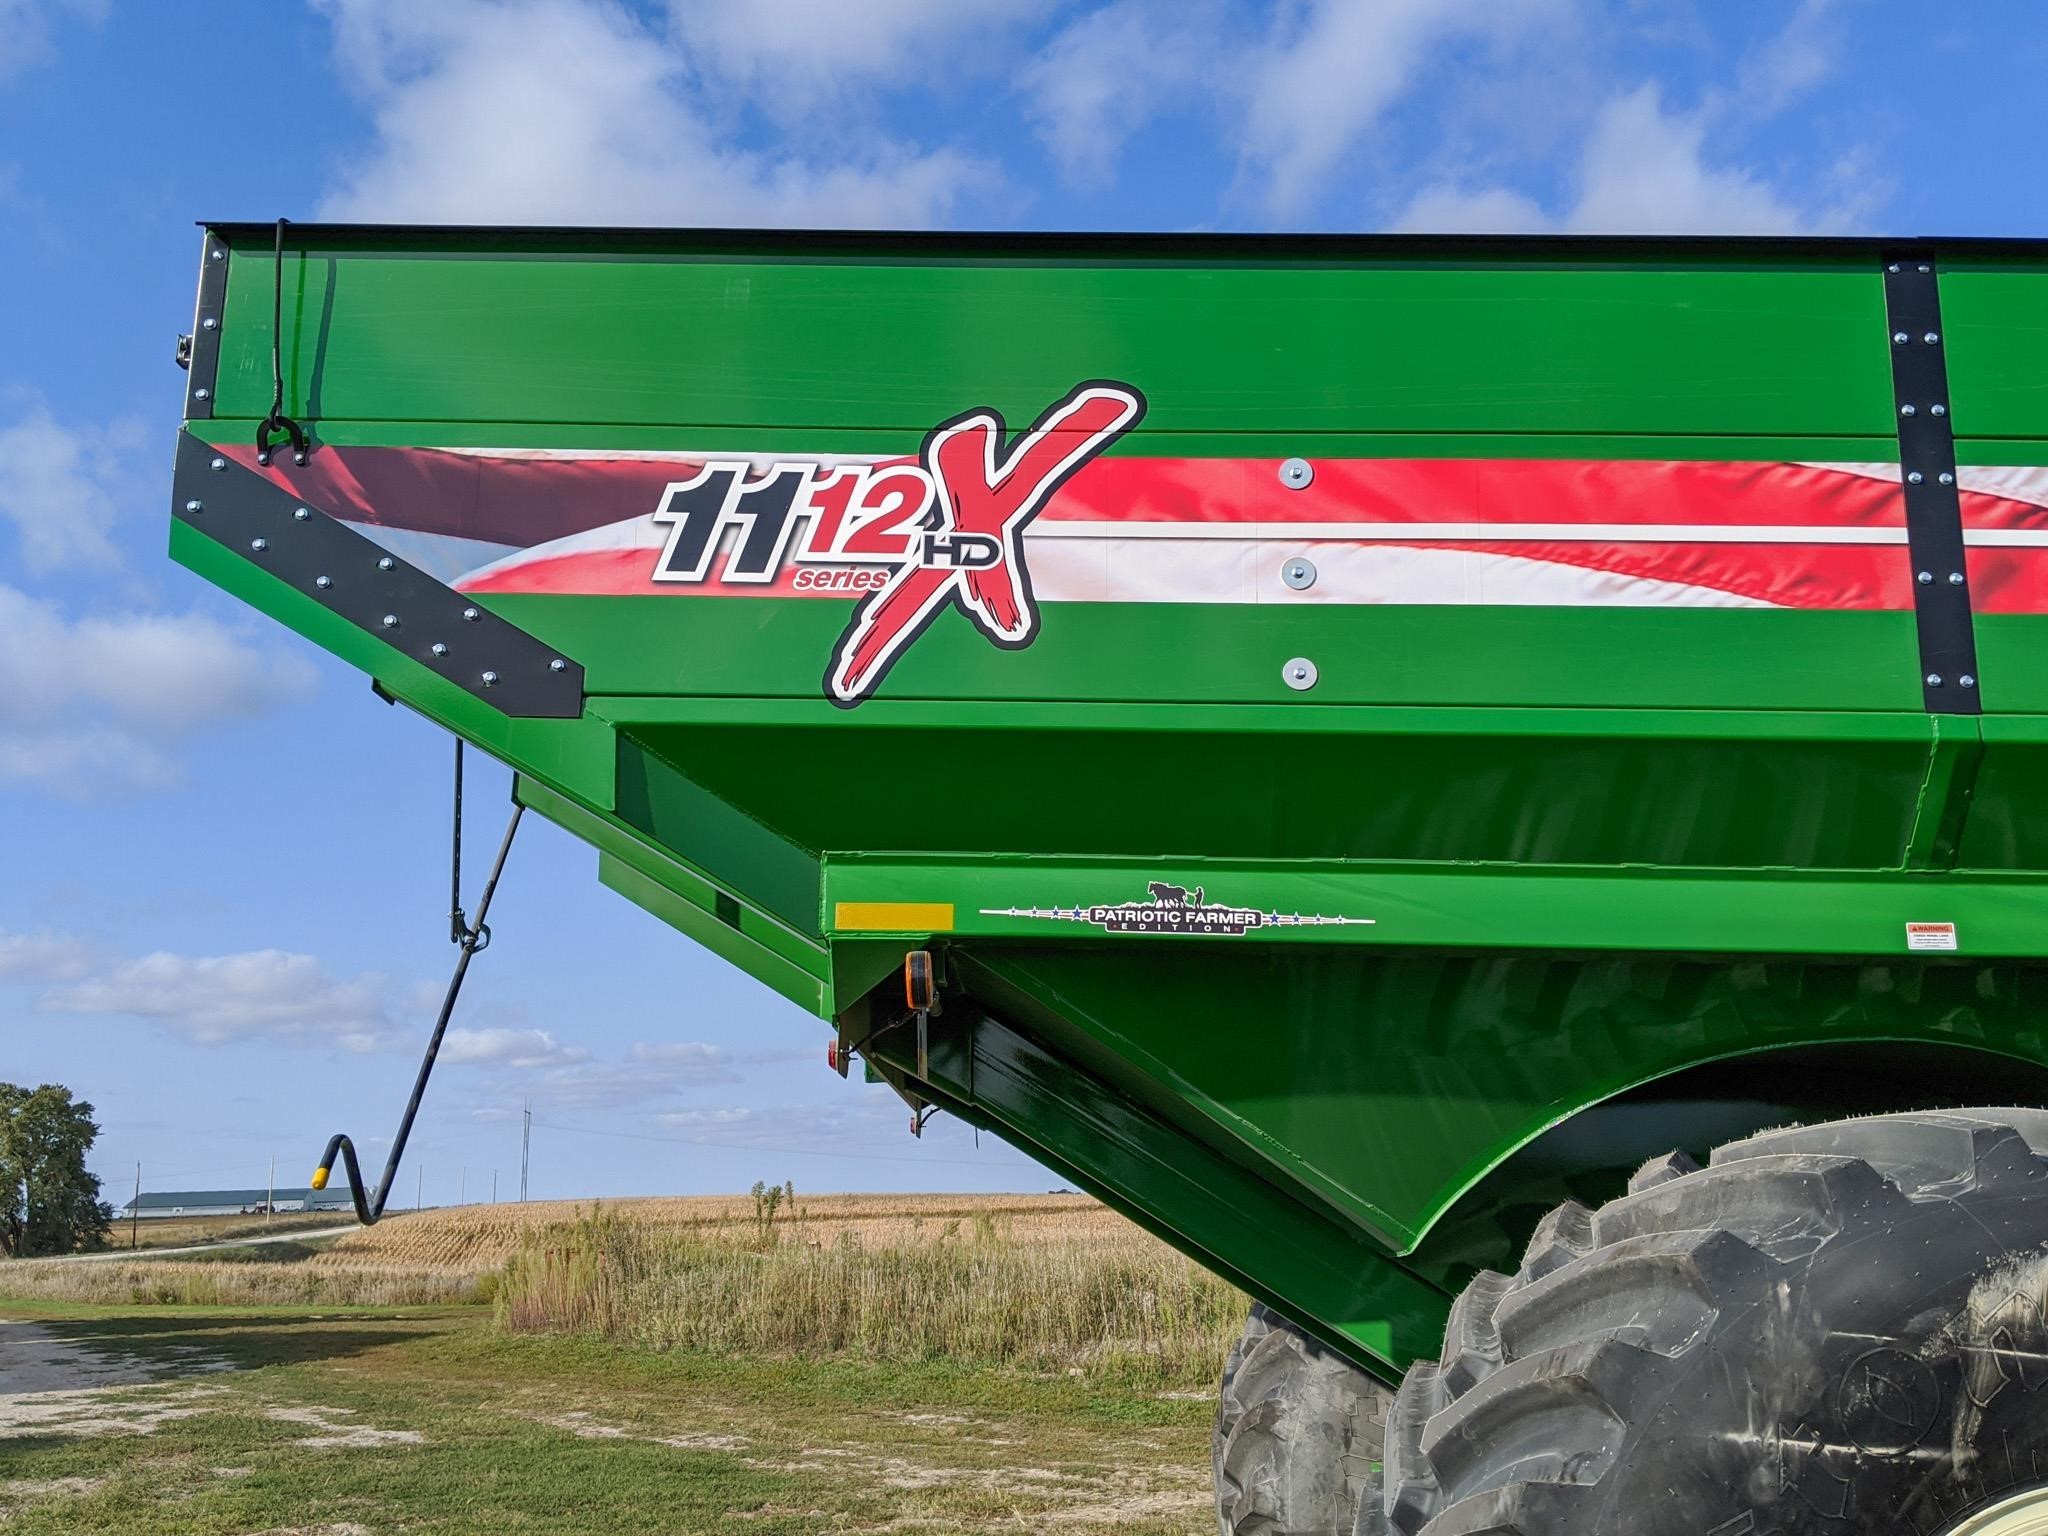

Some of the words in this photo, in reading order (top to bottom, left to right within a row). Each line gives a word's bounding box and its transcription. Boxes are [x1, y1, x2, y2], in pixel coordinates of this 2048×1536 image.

[922, 533, 1002, 568] HD
[795, 566, 888, 590] series
[1094, 909, 1182, 924] PATRIOTIC
[1185, 911, 1257, 925] FARMER
[1121, 922, 1231, 933] EDITION
